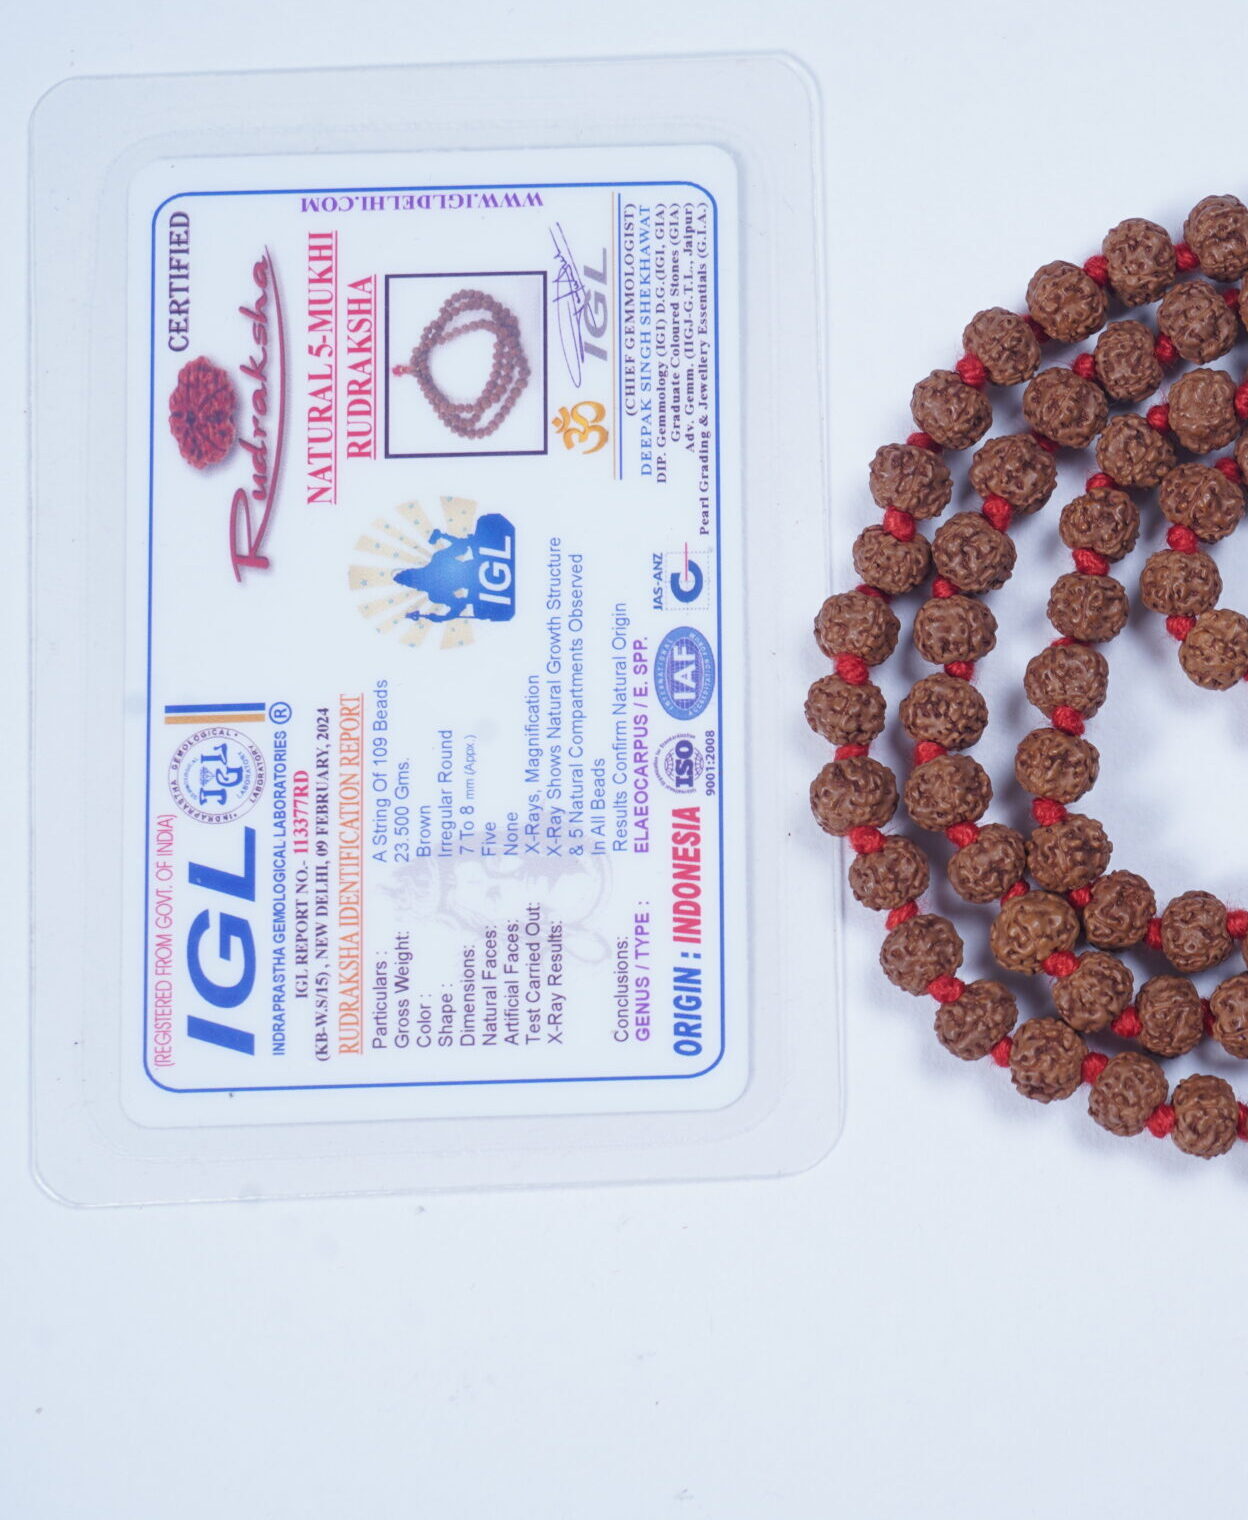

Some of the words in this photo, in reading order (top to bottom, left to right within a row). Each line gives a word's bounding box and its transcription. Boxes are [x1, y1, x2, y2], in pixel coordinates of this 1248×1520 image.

[301, 192, 543, 212] WWW.IGLDELHI.COM
[655, 203, 667, 240] GIA)
[669, 203, 682, 245] (GIA)
[682, 202, 696, 256] Jaipur)
[697, 202, 710, 258] (G.I.A.)
[168, 210, 190, 352] CERTIFIED
[624, 203, 637, 348] GEMMOLOGIST)
[640, 204, 652, 324] SHEKHAWAT
[670, 250, 680, 296] Stones
[307, 231, 334, 357] 5-MUKHI
[584, 247, 608, 362] IGL
[698, 263, 708, 335] Essentials
[640, 332, 652, 391] SINGH
[655, 318, 668, 357] (IGI)
[670, 302, 681, 368] Coloured
[346, 274, 372, 460] RUDRAKSHA
[624, 355, 638, 416] (CHIEF
[684, 362, 696, 415] Gemm.
[698, 340, 712, 410] Jewellery
[229, 244, 285, 583] Rudraksha
[656, 362, 669, 448] Gemmology
[670, 372, 682, 442] Graduate
[699, 416, 710, 426] &
[307, 364, 333, 505] NATURAL
[640, 398, 652, 476] DEEPAK
[684, 420, 696, 452] Adv.
[698, 431, 712, 492] Grading
[656, 452, 667, 484] DIP.
[699, 497, 710, 535] Pearl
[478, 535, 512, 606] IGL
[546, 537, 562, 610] Structure
[568, 554, 584, 632] Observed
[652, 552, 664, 610] JAS-ANZ
[546, 616, 562, 674] Growth
[611, 602, 630, 650] Origin
[633, 636, 648, 675] SPP.
[673, 646, 696, 700] IAF
[372, 680, 388, 731] Beads
[546, 680, 562, 739] Natural
[568, 638, 586, 758] Compartments
[612, 656, 628, 715] Natural
[633, 680, 648, 697] E.
[316, 708, 330, 740] 2024
[339, 693, 361, 766] REPORT
[372, 737, 388, 766] 109
[524, 675, 544, 782] Magnification
[612, 720, 628, 784] Confirm
[372, 772, 388, 792] Of
[394, 758, 410, 800] Gms.
[438, 730, 454, 783] Round
[462, 734, 477, 775] (Appx.)
[546, 744, 562, 799] Shows
[674, 740, 694, 788] ISO
[705, 730, 716, 796] 9001:2008
[273, 730, 287, 837] LABORATORIES
[316, 744, 332, 836] FEBRUARY,
[460, 805, 474, 816] 8
[465, 778, 474, 800] mm
[568, 764, 584, 823] Natural
[590, 758, 606, 810] Beads
[634, 714, 650, 853] ELAEOCARPUS
[156, 814, 177, 856] INDIA)
[293, 770, 310, 854] 113377RD
[372, 798, 391, 846] String
[394, 806, 410, 862] 23.500
[416, 805, 432, 857] Brown
[438, 789, 457, 857] Irregular
[460, 820, 474, 840] To
[482, 822, 496, 856] Five
[504, 812, 519, 856] None
[524, 790, 544, 854] X-Rays,
[546, 806, 566, 856] X-Ray
[568, 828, 584, 838] 5
[591, 816, 606, 836] All
[612, 792, 628, 852] Results
[156, 860, 174, 878] OF
[316, 840, 330, 856] 09
[339, 771, 361, 926] IDENTIFICATION
[373, 850, 388, 862] A
[460, 846, 474, 854] 7
[568, 844, 584, 856] &
[591, 842, 606, 855] In
[672, 806, 702, 944] INDONESIA
[156, 884, 174, 929] GOVT.
[272, 843, 286, 943] GEMOLOGICAL
[316, 860, 332, 917] DELHI,
[186, 826, 256, 1056] IGL
[294, 899, 310, 965] REPORT
[316, 920, 330, 959] NEW
[504, 919, 520, 974] Faces:
[525, 902, 541, 936] Out:
[635, 912, 650, 960] TYPE
[156, 934, 173, 975] FROM
[394, 931, 412, 993] Weight:
[482, 925, 497, 980] Faces:
[525, 942, 541, 1003] Carried
[547, 920, 562, 986] Results:
[272, 947, 286, 1056] INDRAPRASTHA
[294, 969, 310, 999] IGL
[339, 928, 361, 1054] RUDRAKSHA
[372, 960, 388, 1049] Particulars
[460, 944, 476, 1046] Dimensions:
[613, 936, 629, 1042] Conclusions:
[635, 976, 650, 1041] GENUS
[672, 966, 702, 1056] ORIGIN
[155, 980, 174, 1067] (REGISTERED
[394, 998, 410, 1049] Gross
[416, 1003, 432, 1048] Color
[438, 993, 457, 1047] Shape
[482, 986, 497, 1046] Natural
[504, 980, 520, 1046] Artificial
[526, 1008, 541, 1044] Test
[547, 992, 566, 1044] X-Ray
